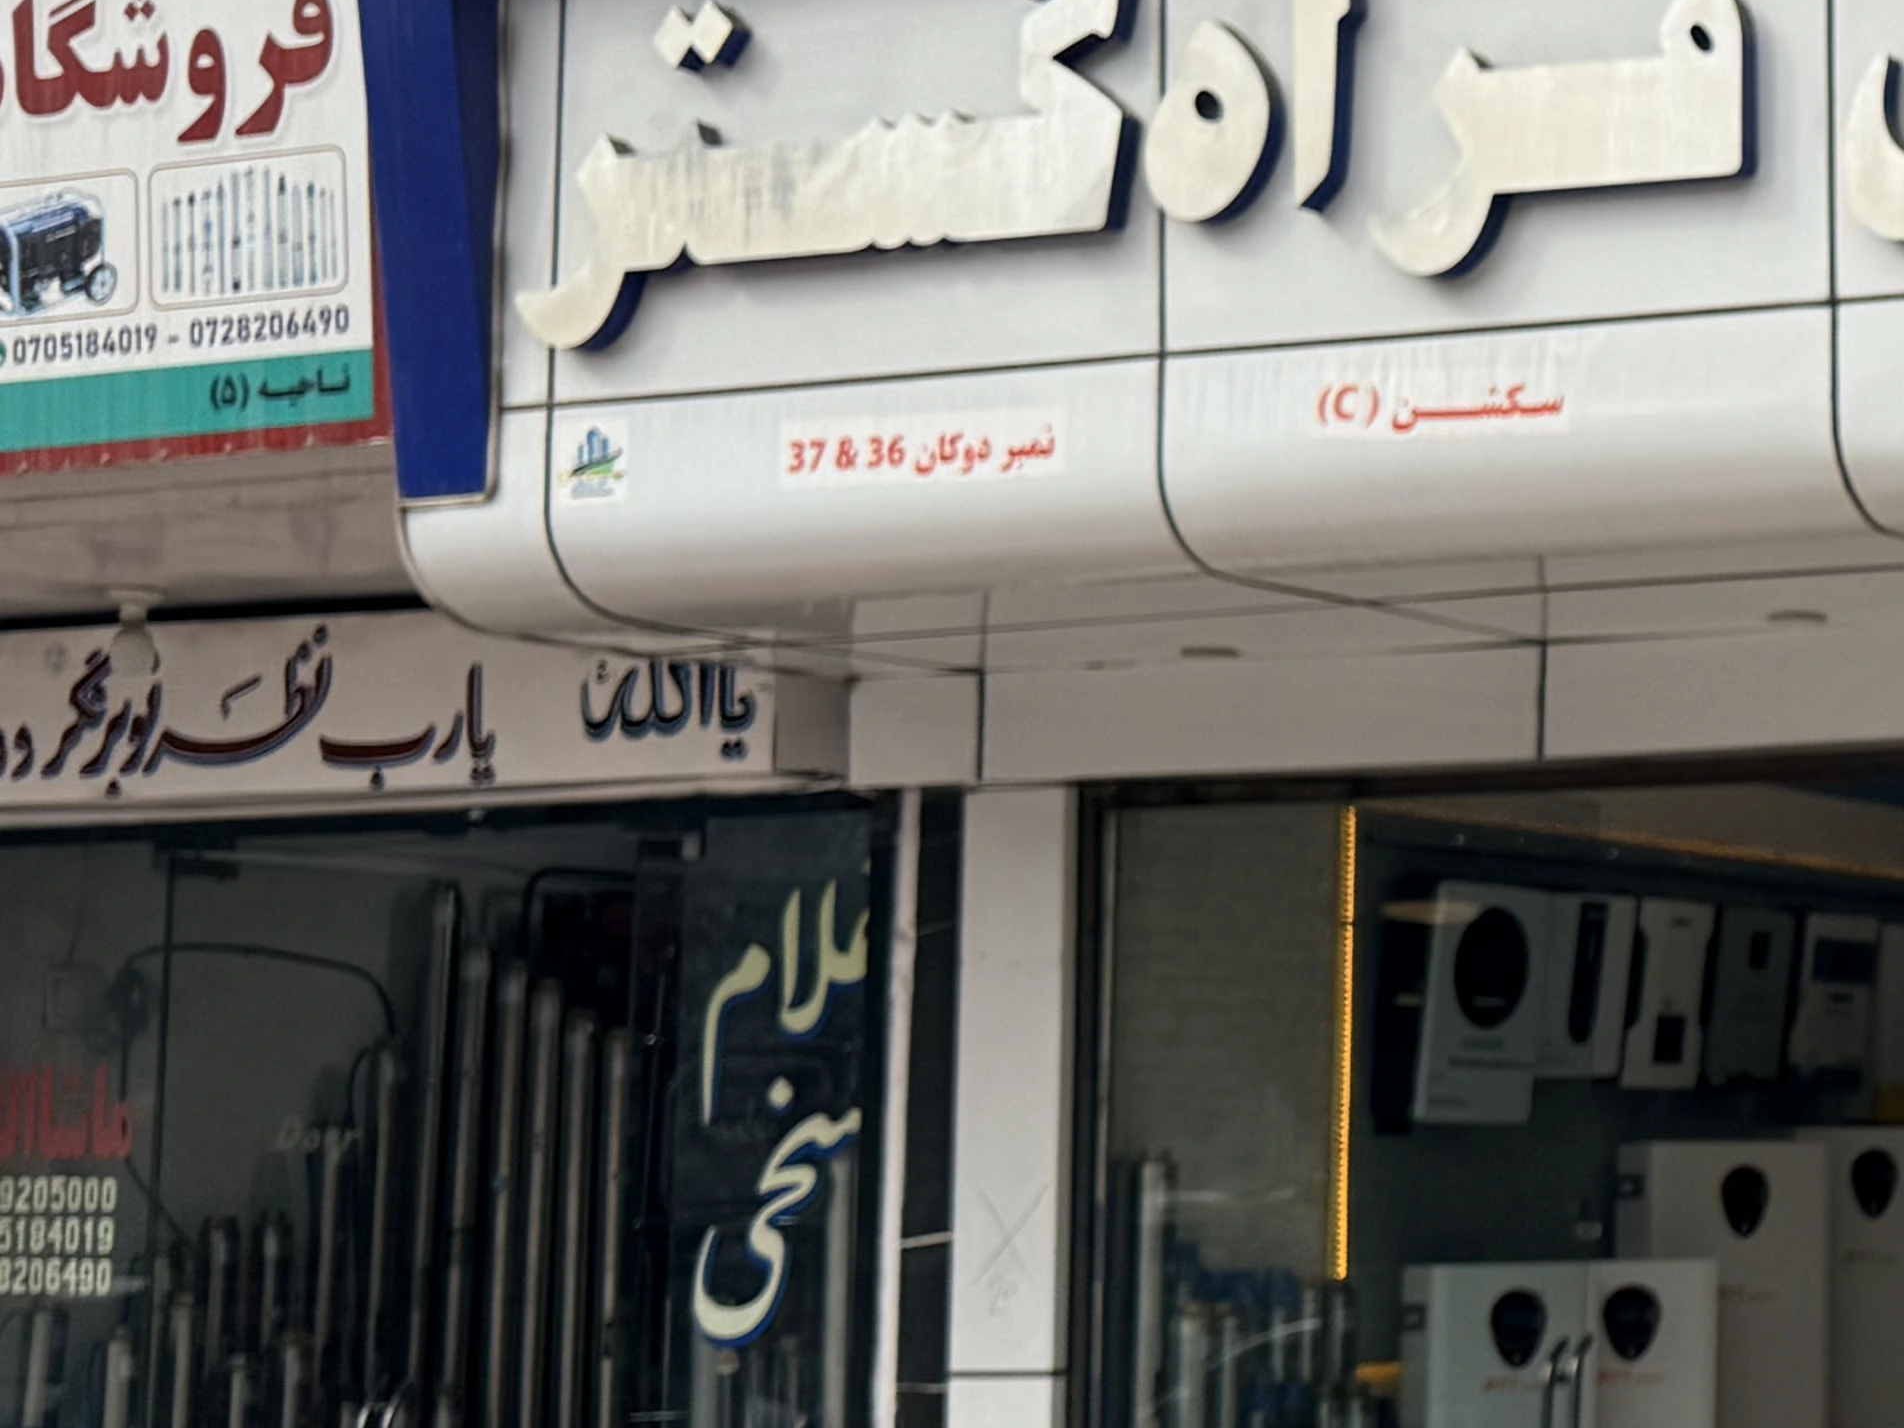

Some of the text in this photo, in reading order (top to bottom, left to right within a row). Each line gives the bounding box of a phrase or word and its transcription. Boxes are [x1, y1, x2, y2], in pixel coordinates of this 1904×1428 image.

[13, 324, 158, 365] 0705184019
[189, 304, 350, 348] 0728206490
[1316, 381, 1564, 434] سکشن (C)
[787, 423, 1056, 476] نمبر دوکان 36 & 37
